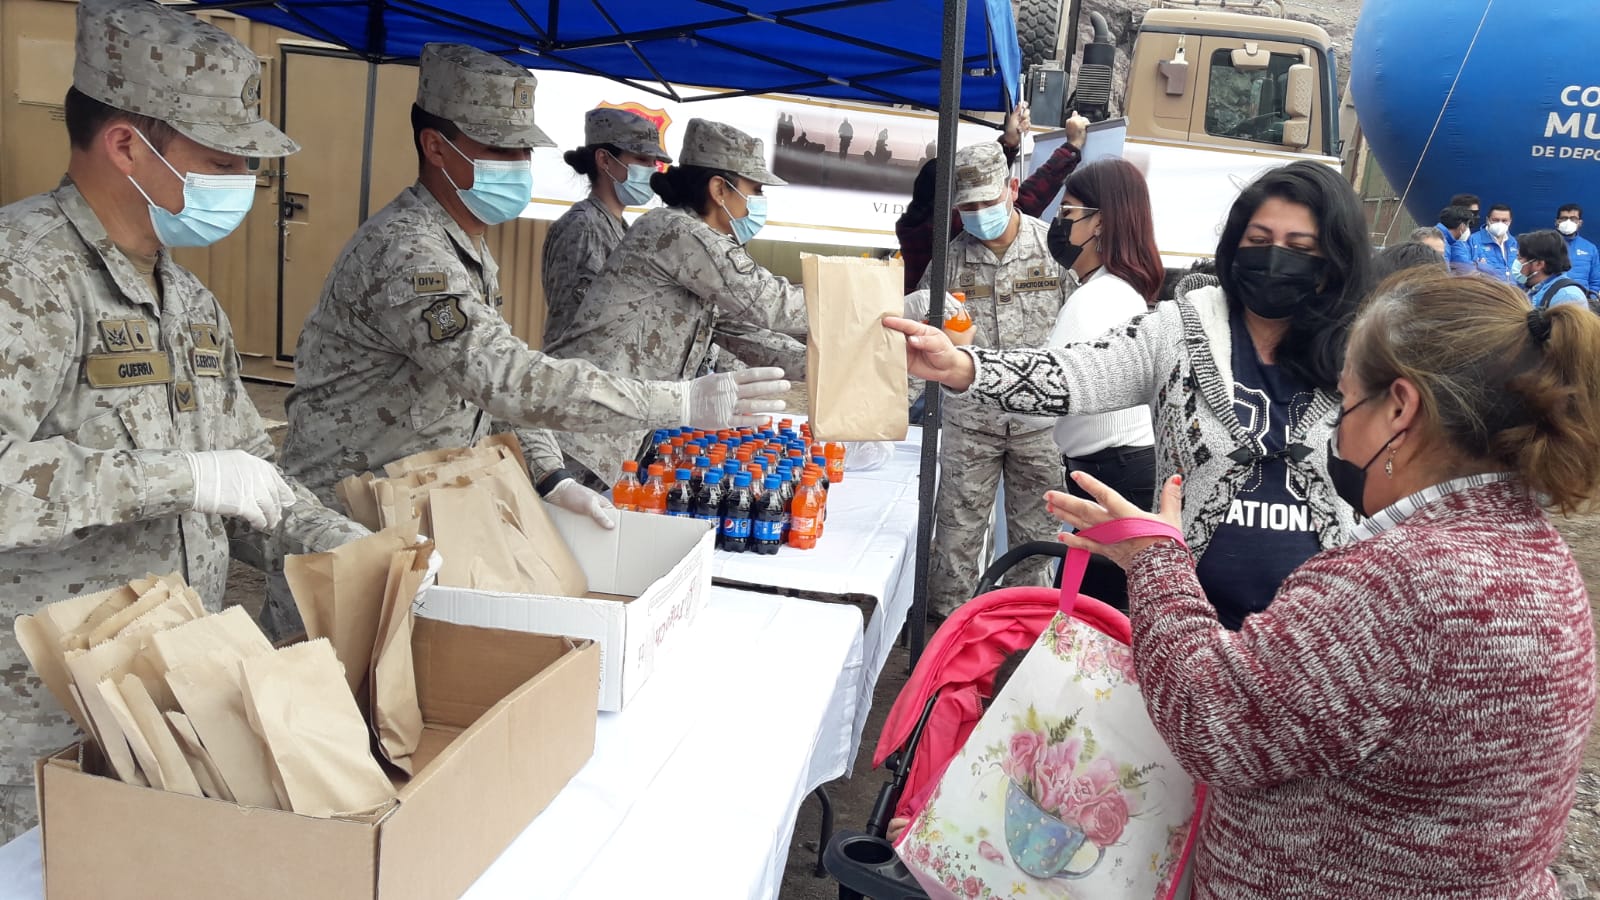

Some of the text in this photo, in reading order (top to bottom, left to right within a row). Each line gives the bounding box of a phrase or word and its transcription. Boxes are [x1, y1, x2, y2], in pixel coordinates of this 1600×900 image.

[1560, 85, 1600, 107] CO
[1531, 145, 1556, 157] DE
[872, 201, 888, 214] VI
[118, 362, 155, 378] GUERRA
[1219, 499, 1319, 532] ATION
